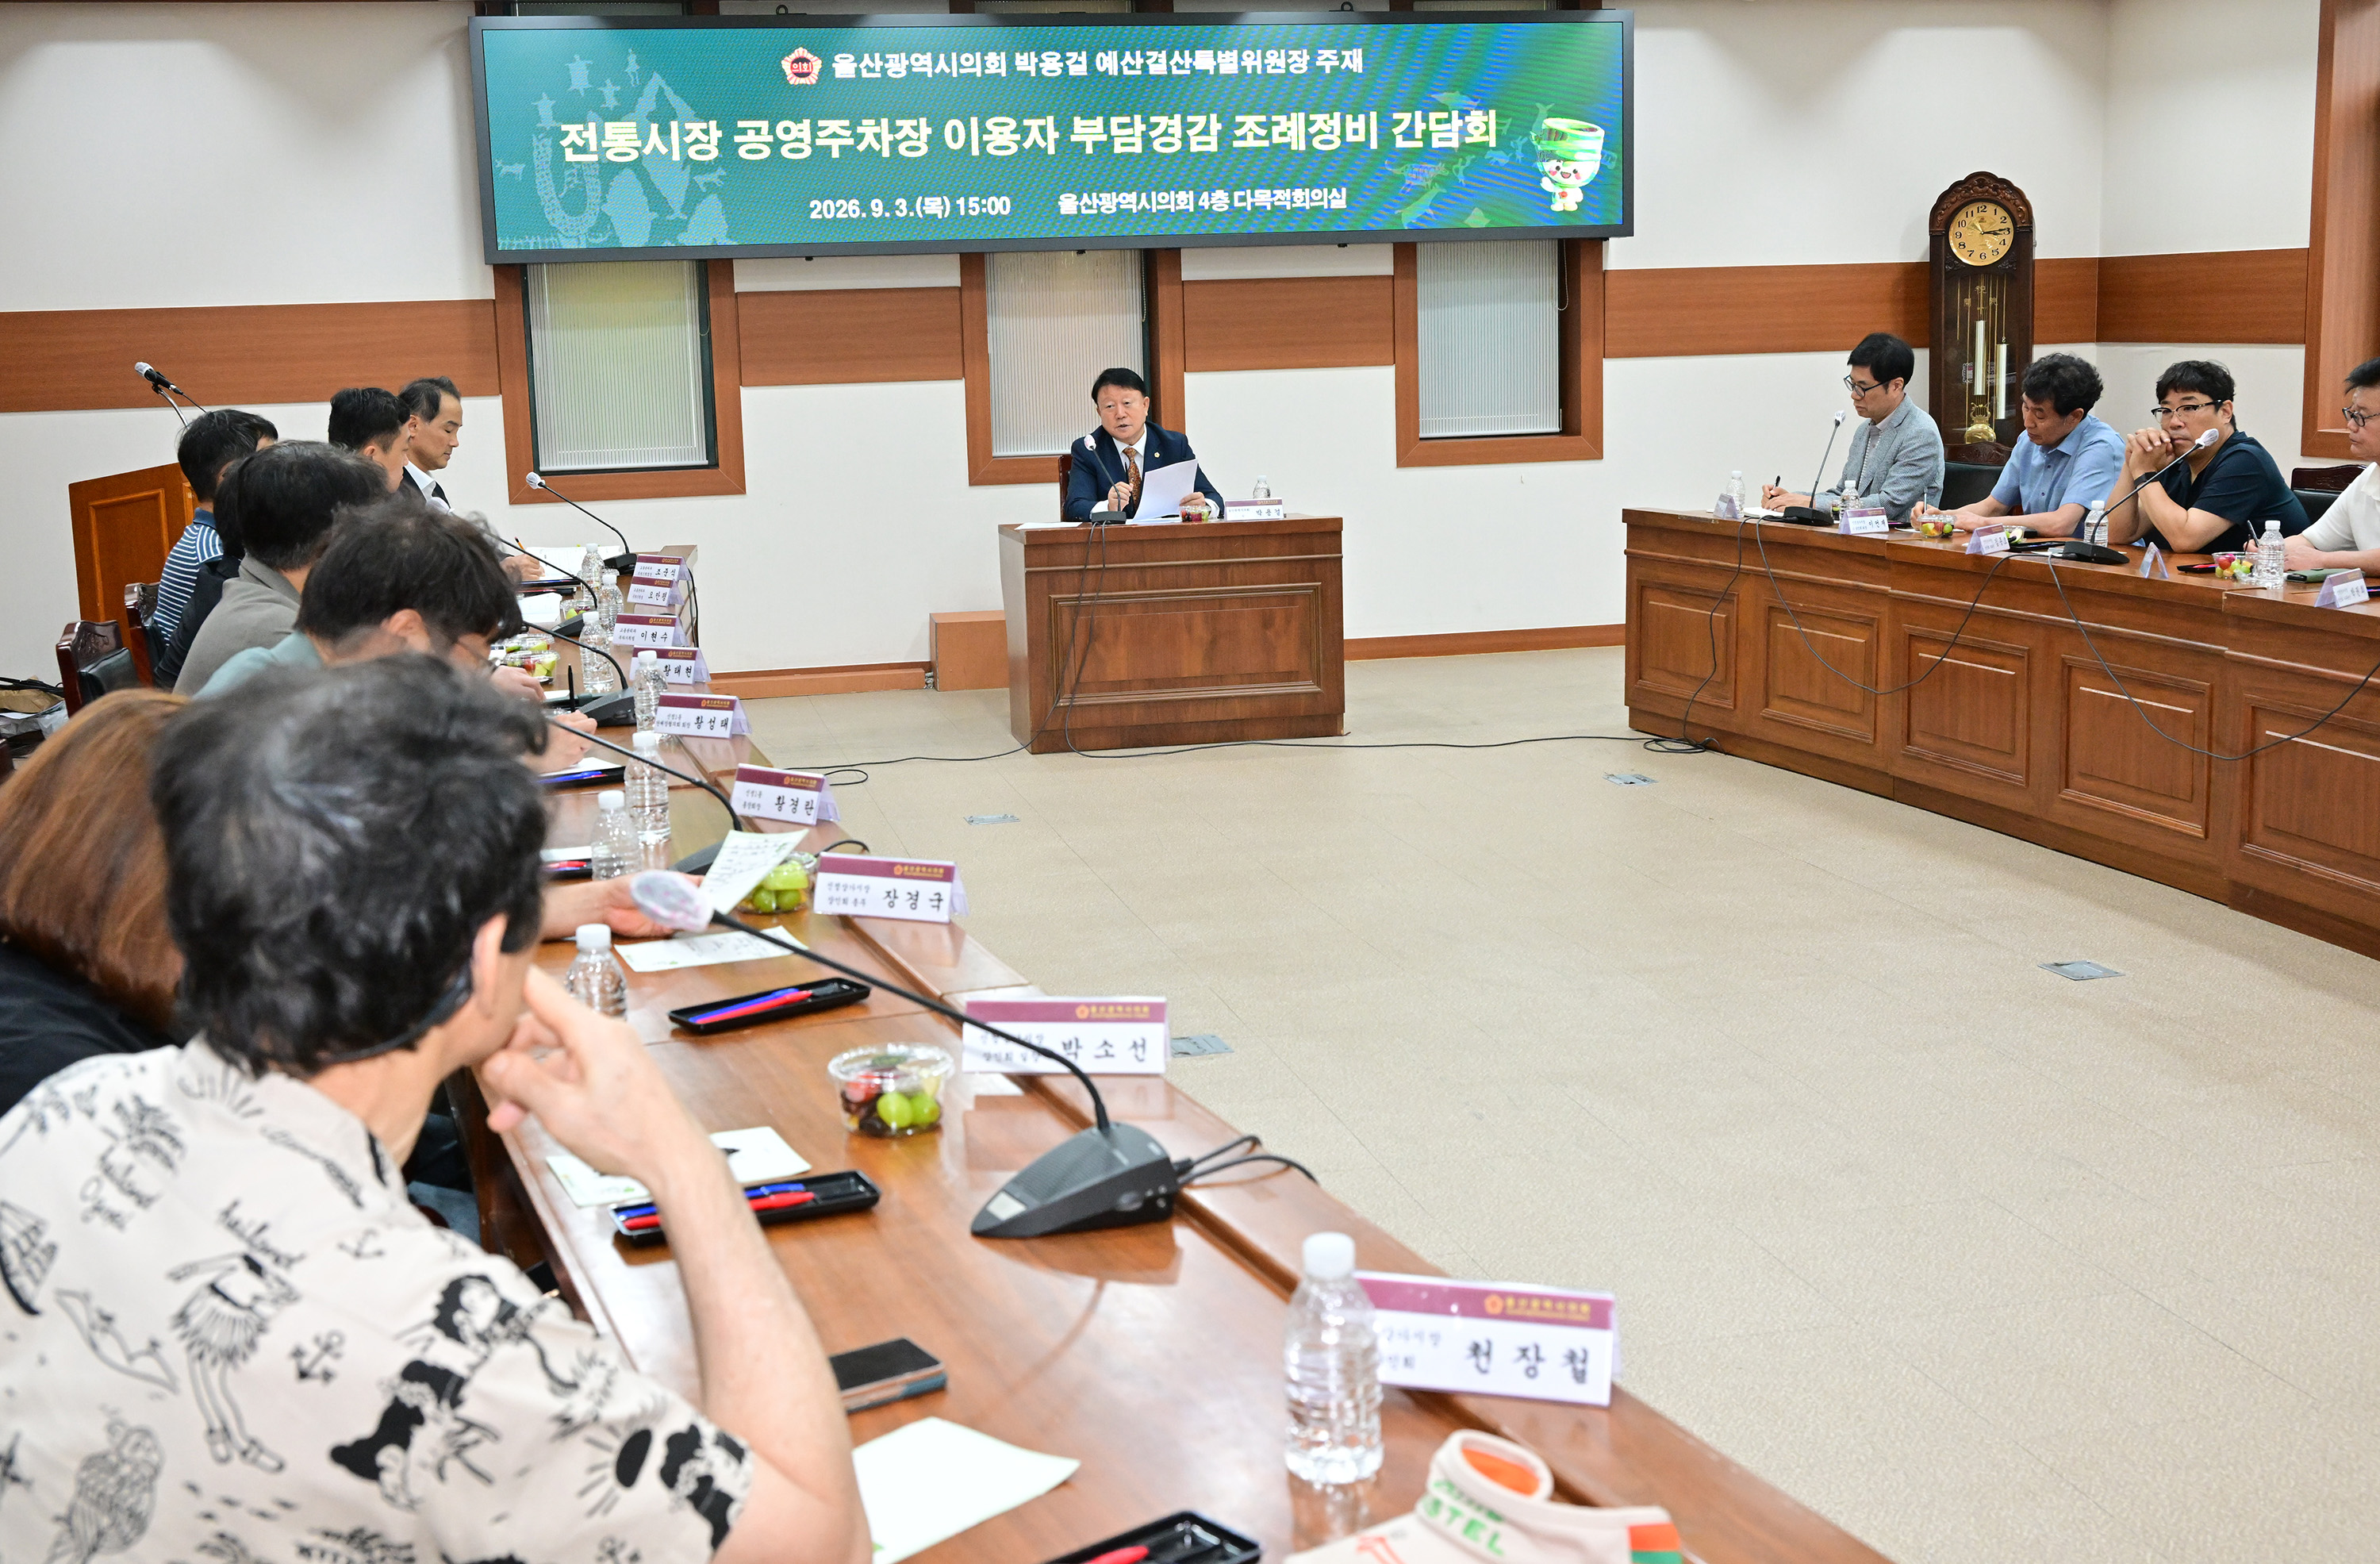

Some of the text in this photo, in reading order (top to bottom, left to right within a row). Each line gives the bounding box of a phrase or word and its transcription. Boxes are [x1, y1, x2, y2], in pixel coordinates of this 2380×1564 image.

[792, 61, 812, 72] 의회
[831, 48, 1364, 79] 울산광역시의회 박용걸 예산결산특별위원장 주재
[559, 110, 1497, 163] 전통시장 공영주차장 이용자 부담경감 조례정비 간담회
[809, 198, 866, 219] 2026.
[871, 198, 890, 218] 9.
[956, 196, 1012, 217] 15:00
[1058, 187, 1348, 215] 울산광역시의회 4층 다목적회의실
[1977, 205, 1987, 213] 12
[1966, 209, 1974, 218] 11
[1958, 241, 1967, 250] 8
[1967, 249, 1975, 258] 7
[694, 715, 729, 731] 황성태
[774, 795, 814, 816] 황경란
[883, 888, 944, 912] 장경국
[1061, 1036, 1147, 1063] 박소선
